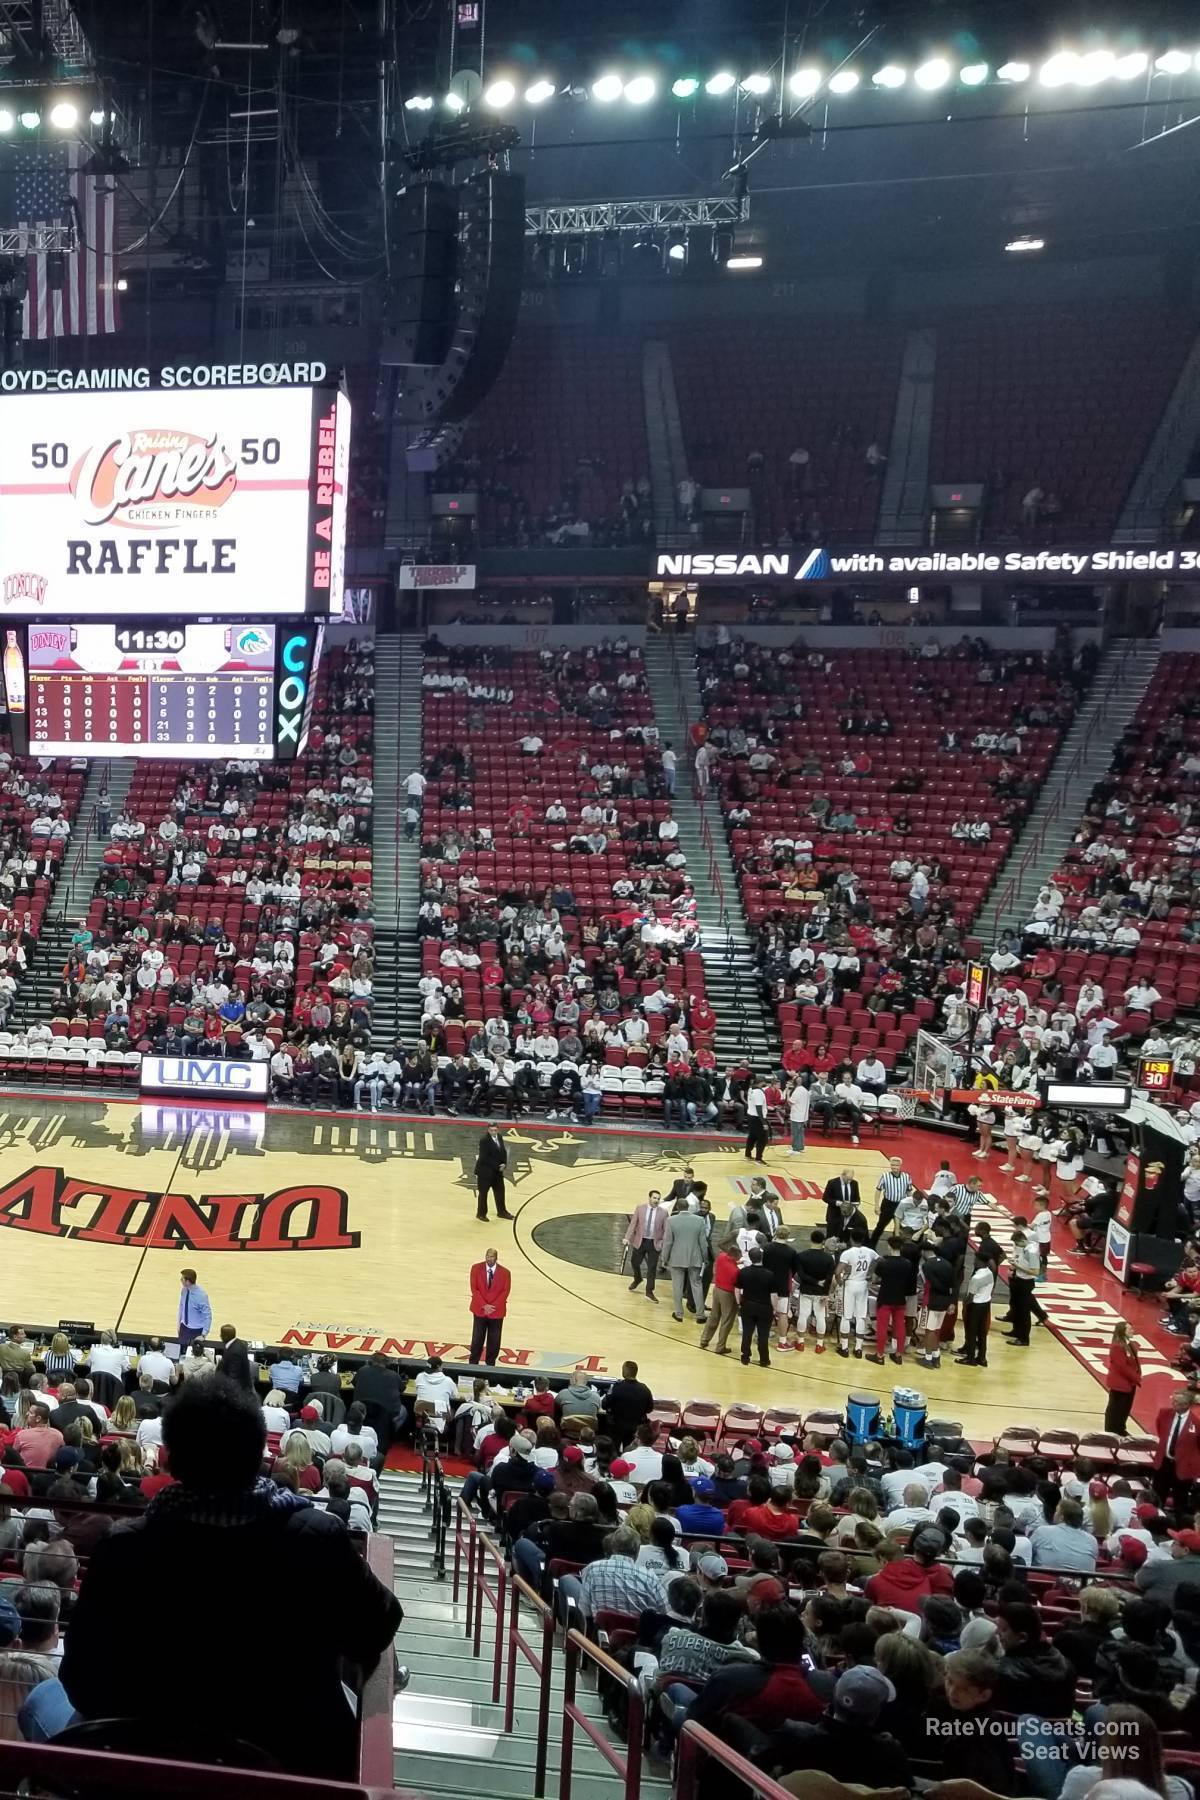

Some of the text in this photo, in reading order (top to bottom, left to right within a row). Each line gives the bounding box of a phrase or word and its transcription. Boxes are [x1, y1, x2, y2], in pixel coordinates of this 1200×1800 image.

[57, 368, 151, 390] GAMING
[160, 362, 327, 388] SCOREBOARD
[31, 442, 68, 469] 50
[241, 438, 281, 465] 50
[74, 432, 238, 526] Cane's
[313, 403, 337, 588] BE A REBEL.
[67, 538, 237, 574] RAFFLE
[657, 554, 789, 575] NISSAN
[831, 552, 883, 573] with
[889, 551, 1000, 571] available
[1004, 551, 1089, 576] Safety
[1091, 550, 1174, 570] Shield
[3, 571, 49, 606] UNLV
[31, 632, 67, 652] UNLV
[117, 630, 184, 649] 11:30
[38, 684, 140, 694] 3 3 3 1 1
[187, 686, 194, 694] 0
[208, 686, 216, 694] 2
[234, 686, 242, 694] 0
[259, 686, 267, 695] 0
[278, 636, 307, 743] COX
[64, 697, 71, 705] 0
[85, 697, 92, 705] 0
[110, 697, 116, 706] 1
[134, 697, 141, 706] 0
[160, 697, 267, 707] 3 3 1 1 0
[35, 708, 141, 718] 13 0 0 0 0
[187, 710, 194, 718] 0
[208, 710, 216, 718] 0
[234, 710, 241, 718] 0
[259, 710, 266, 719] 0
[64, 721, 71, 729] 3
[85, 721, 92, 729] 2
[110, 721, 117, 729] 0
[134, 721, 141, 730] 0
[157, 721, 266, 731] 21 3 1 1 0
[64, 732, 70, 740] 1
[85, 733, 92, 741] 0
[110, 733, 117, 741] 0
[134, 733, 141, 741] 0
[157, 733, 265, 743] 33 0 0 1 1
[158, 1060, 252, 1089] UMC
[1146, 1072, 1163, 1085] 30
[856, 1260, 868, 1272] 20
[668, 1636, 712, 1656] SUPER
